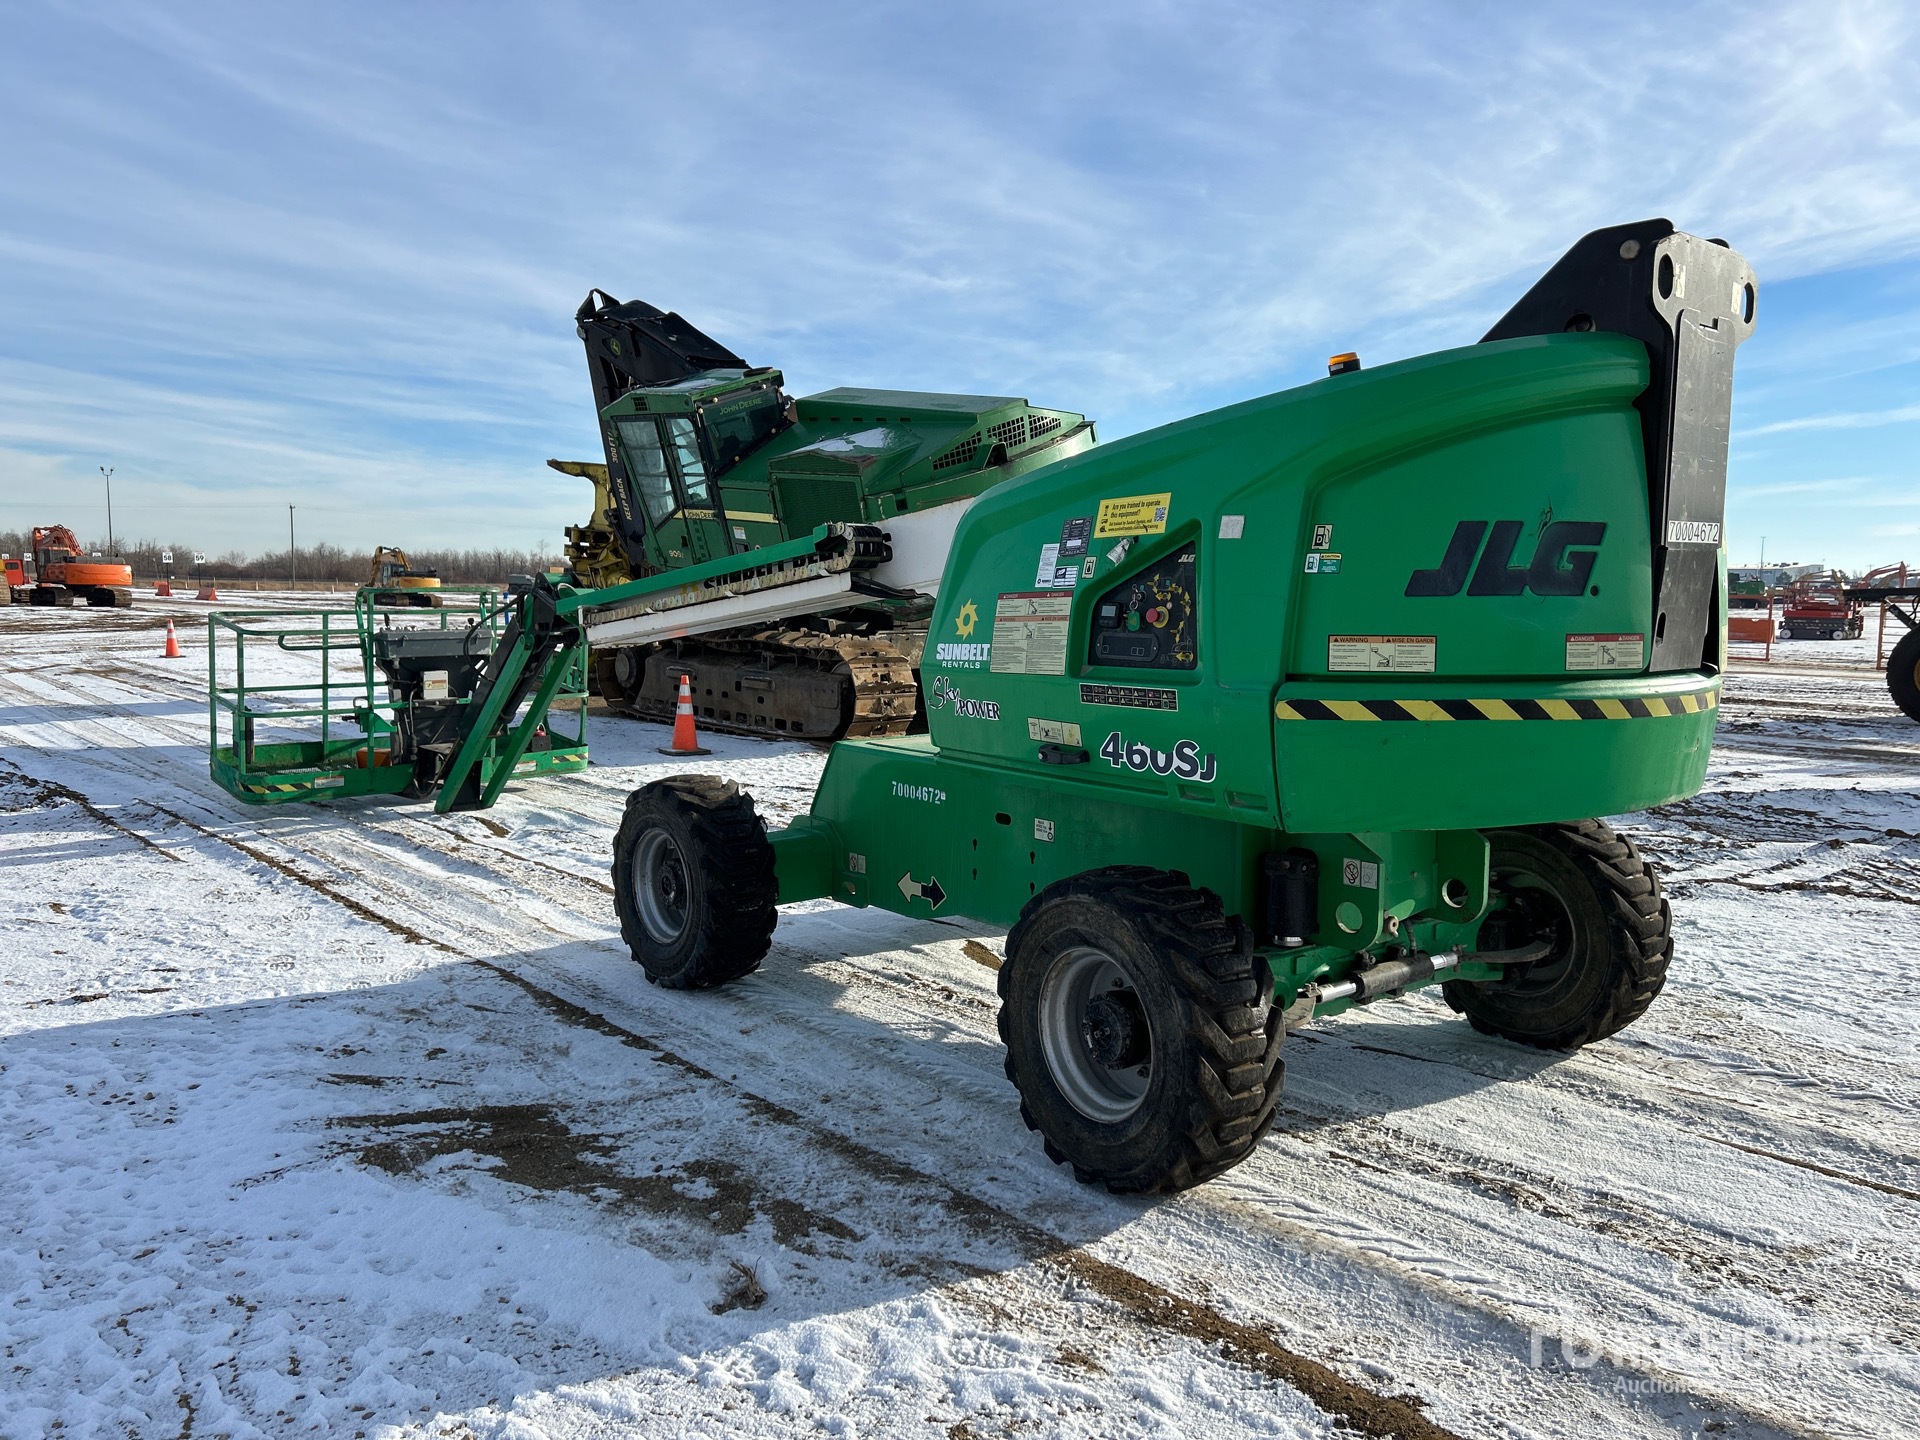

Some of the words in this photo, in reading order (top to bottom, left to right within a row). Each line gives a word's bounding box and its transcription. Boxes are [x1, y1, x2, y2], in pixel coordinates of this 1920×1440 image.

[719, 405, 739, 416] JOHN
[738, 397, 763, 410] DEERE
[1670, 521, 1719, 542] 70004672
[1177, 554, 1196, 563] JLG
[936, 643, 990, 661] SUNBELT
[942, 660, 981, 669] RENTALS
[957, 698, 1000, 720] POWER
[891, 780, 941, 804] 70004672
